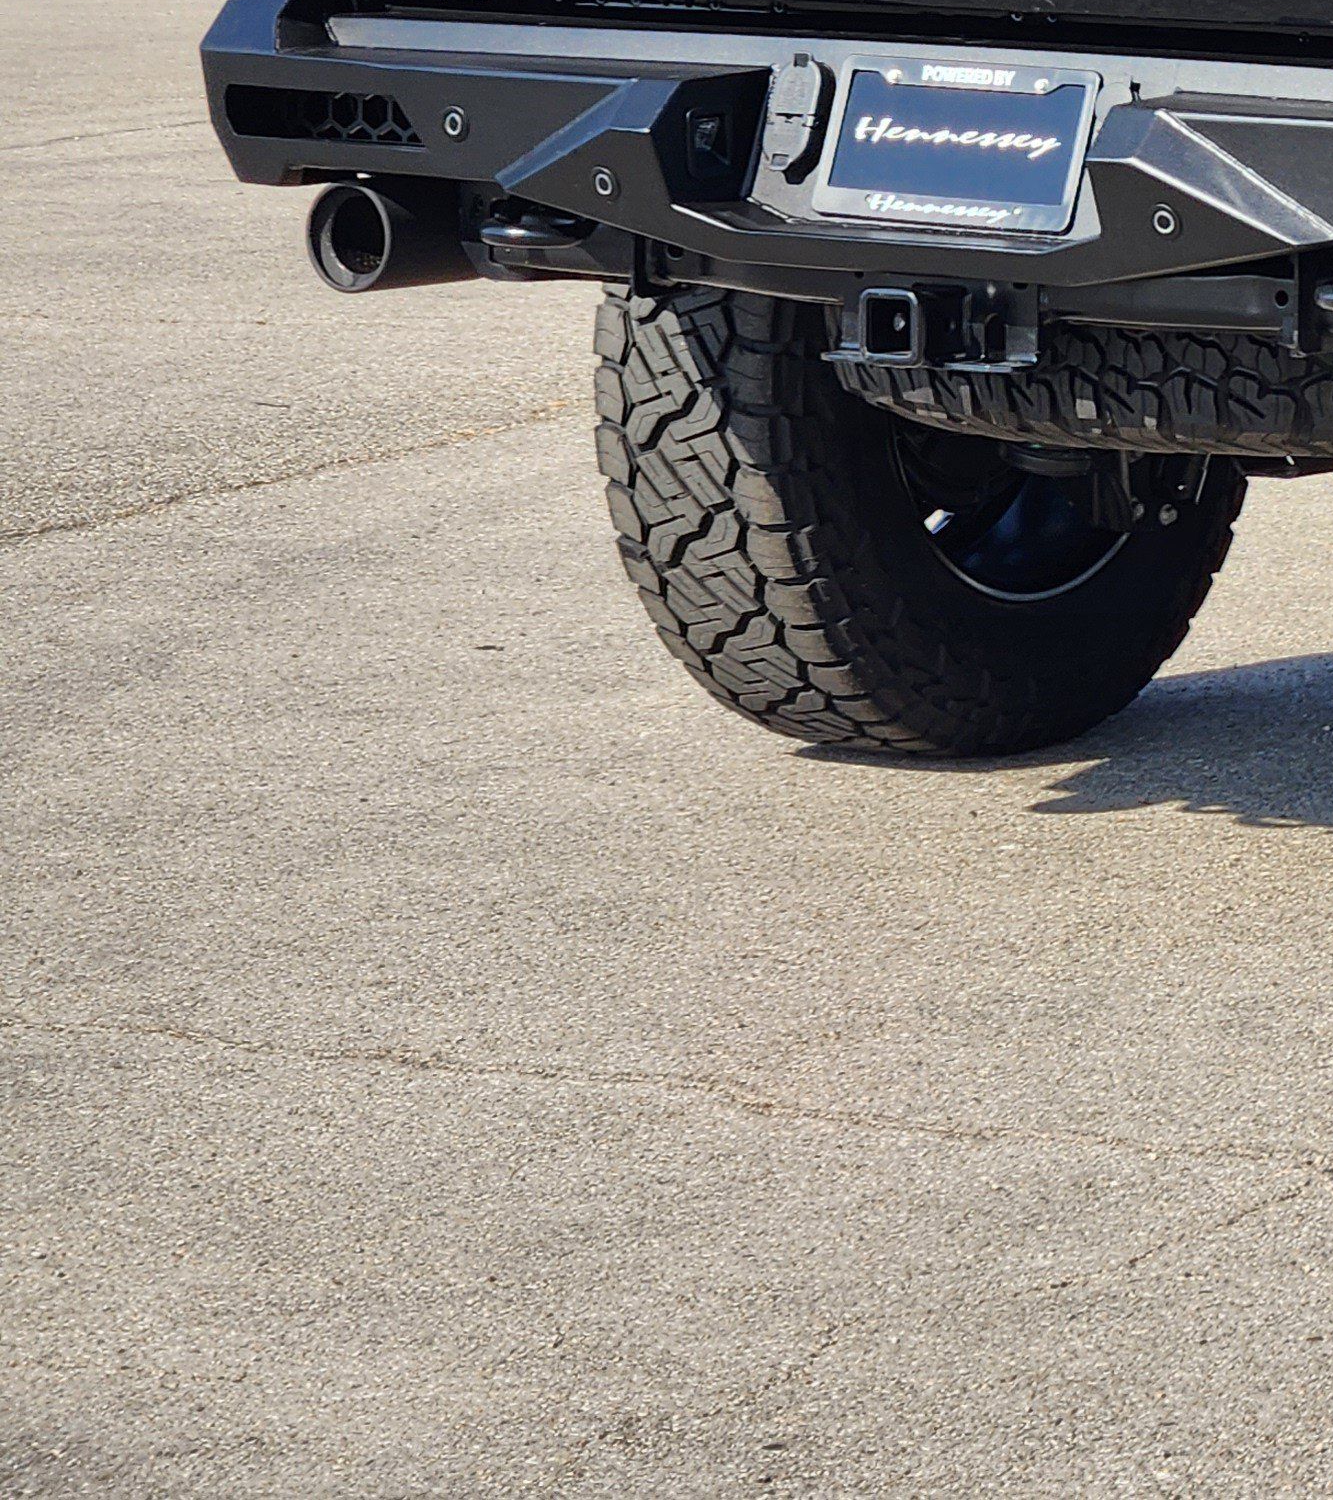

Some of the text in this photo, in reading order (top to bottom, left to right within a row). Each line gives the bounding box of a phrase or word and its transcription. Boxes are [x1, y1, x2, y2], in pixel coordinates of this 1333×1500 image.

[921, 64, 1016, 87] POWERED BY
[854, 116, 1062, 161] Hennessey
[867, 193, 1011, 224] Hennessey
